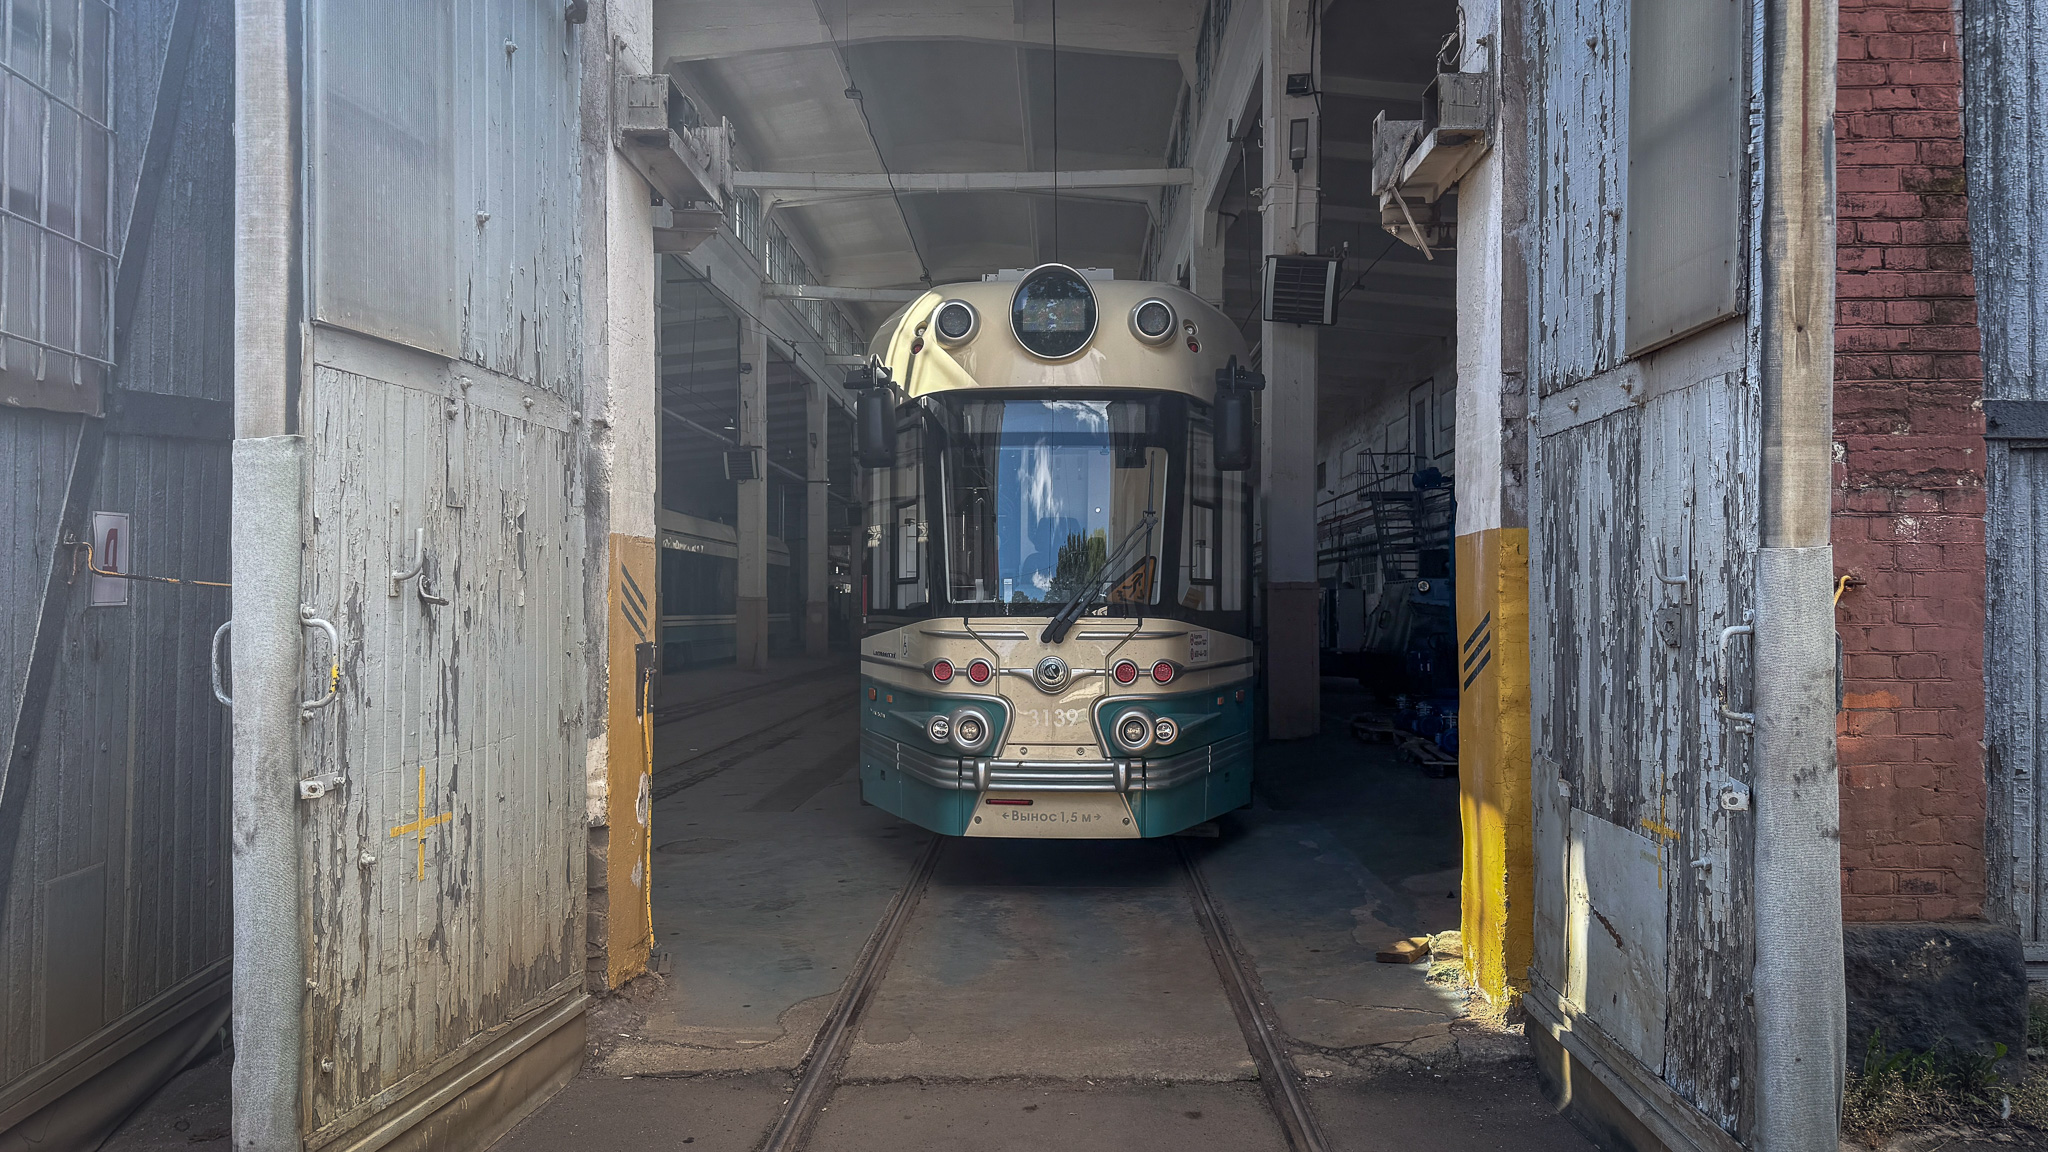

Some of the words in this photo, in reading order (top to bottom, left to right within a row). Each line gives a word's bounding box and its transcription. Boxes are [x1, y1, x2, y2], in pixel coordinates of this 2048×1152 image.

[1027, 708, 1079, 728] 3139
[1011, 810, 1058, 822] Вынос
[1060, 811, 1078, 824] 1,5
[1081, 813, 1092, 823] м
